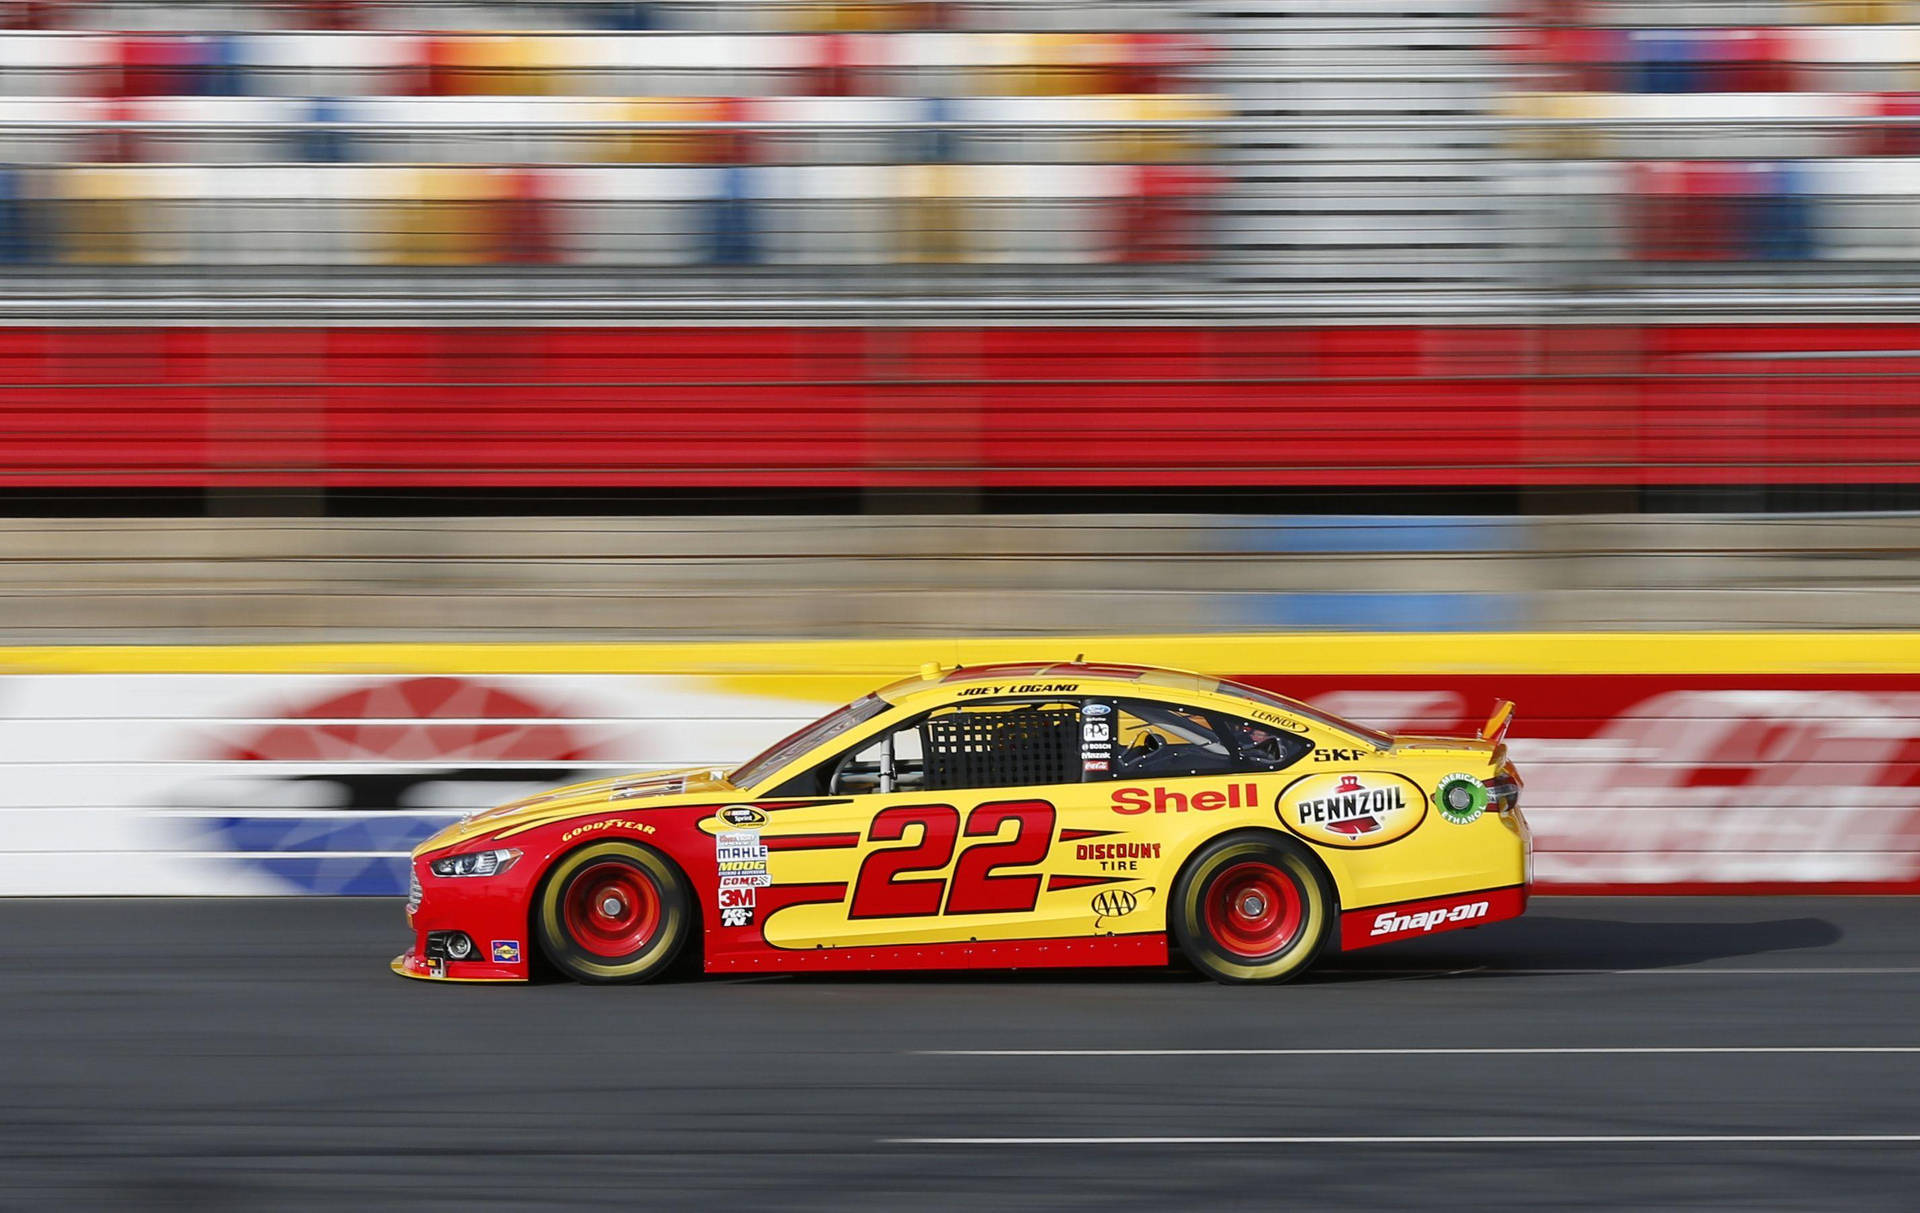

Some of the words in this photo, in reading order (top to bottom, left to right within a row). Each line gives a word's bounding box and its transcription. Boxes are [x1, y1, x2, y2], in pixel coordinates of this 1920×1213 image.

[957, 686, 1004, 696] JOEY
[1009, 684, 1080, 694] LOGANO
[1251, 709, 1298, 730] LENNOX
[1085, 723, 1108, 738] PPG
[1081, 752, 1111, 760] Mazak
[1314, 749, 1368, 762] SKF
[1438, 772, 1484, 791] AMERICAN
[1111, 783, 1258, 815] Shell
[1299, 786, 1406, 825] PENNZOIL
[1441, 805, 1487, 825] ETHANOL
[562, 819, 656, 842] GOODYEAR
[718, 847, 767, 859] MAHLE
[847, 799, 1056, 920] 22
[1076, 843, 1161, 860] DISCOUNT
[719, 861, 765, 872] MOOG
[1100, 861, 1138, 871] TIRE
[723, 876, 759, 886] COMP
[720, 889, 754, 907] 3M
[1097, 889, 1133, 916] AAA
[1370, 901, 1489, 936] Snap-on
